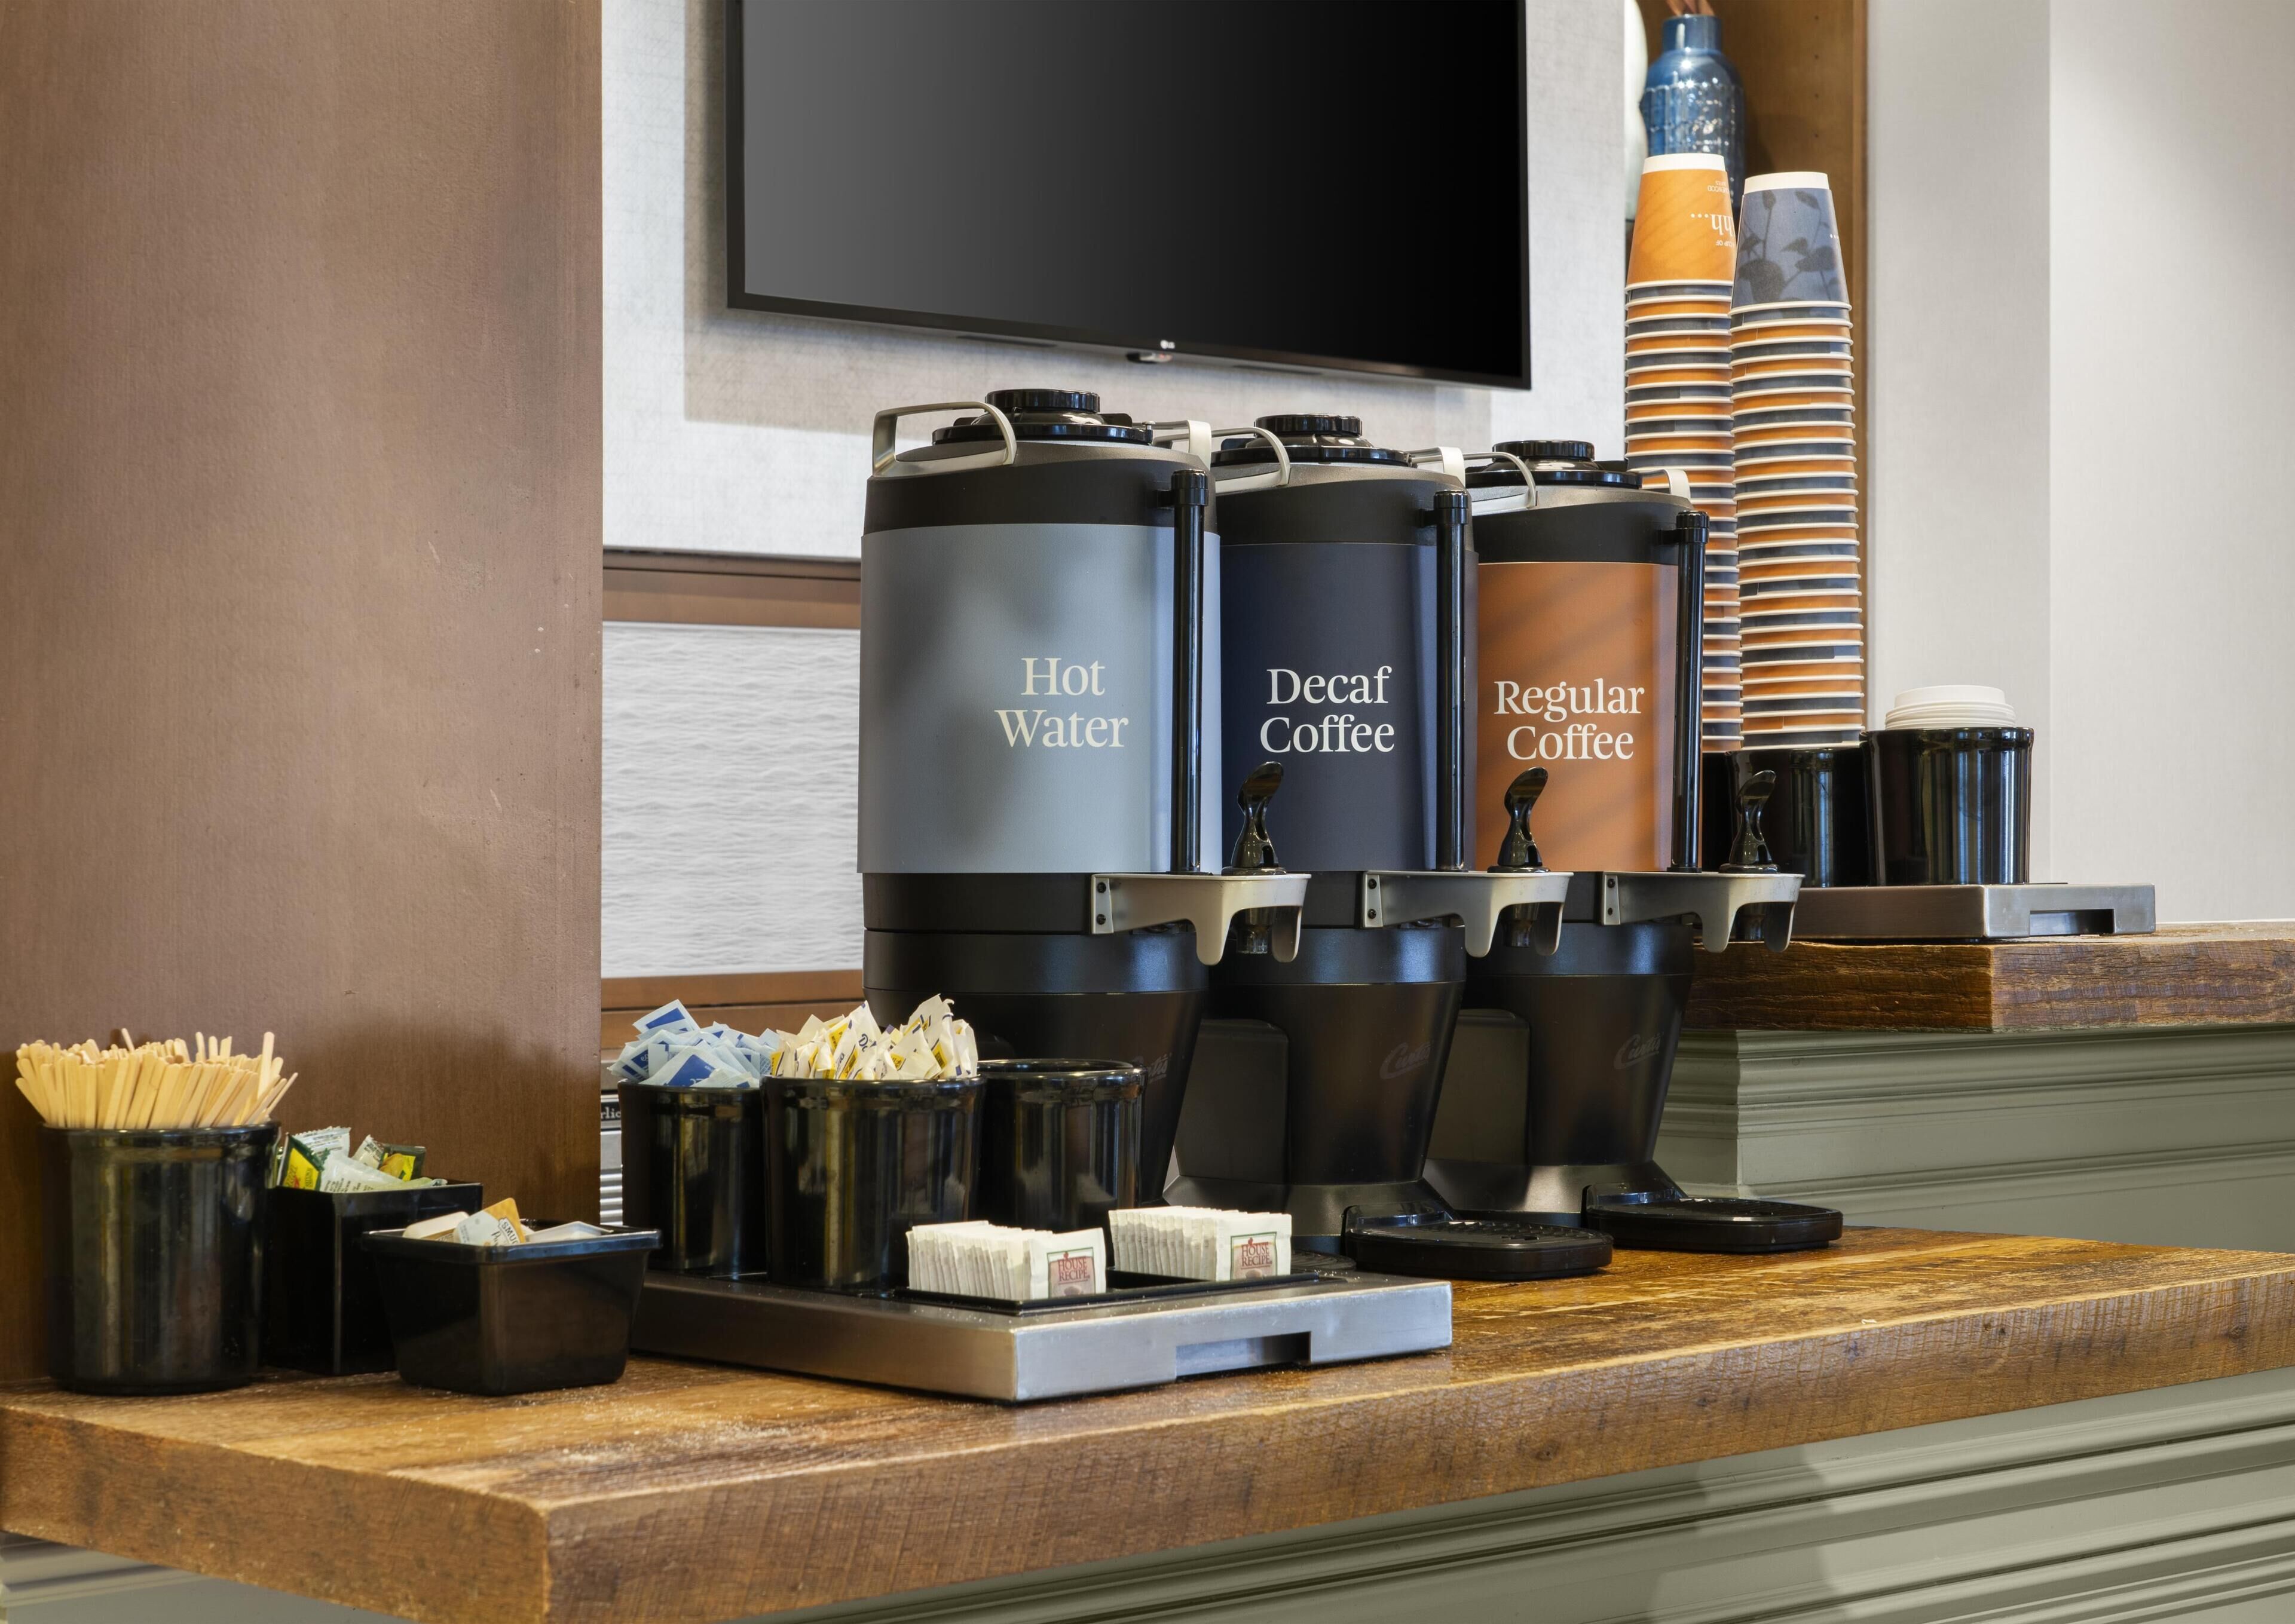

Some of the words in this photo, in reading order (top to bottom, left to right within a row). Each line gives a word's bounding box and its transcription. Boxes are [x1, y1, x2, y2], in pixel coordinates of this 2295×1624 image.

[1691, 213, 1734, 237] hh...
[1021, 658, 1106, 697] Hot
[1267, 666, 1393, 704] Decaf
[1495, 678, 1645, 722] Regular
[995, 710, 1130, 748] Water
[1260, 714, 1395, 753] Coffee
[1507, 721, 1635, 761] Coffee
[1058, 1257, 1088, 1271] HOUSE
[1241, 1242, 1269, 1257] HOUSE
[1242, 1255, 1270, 1267] RECIPE
[1058, 1269, 1088, 1282] RECIPE
